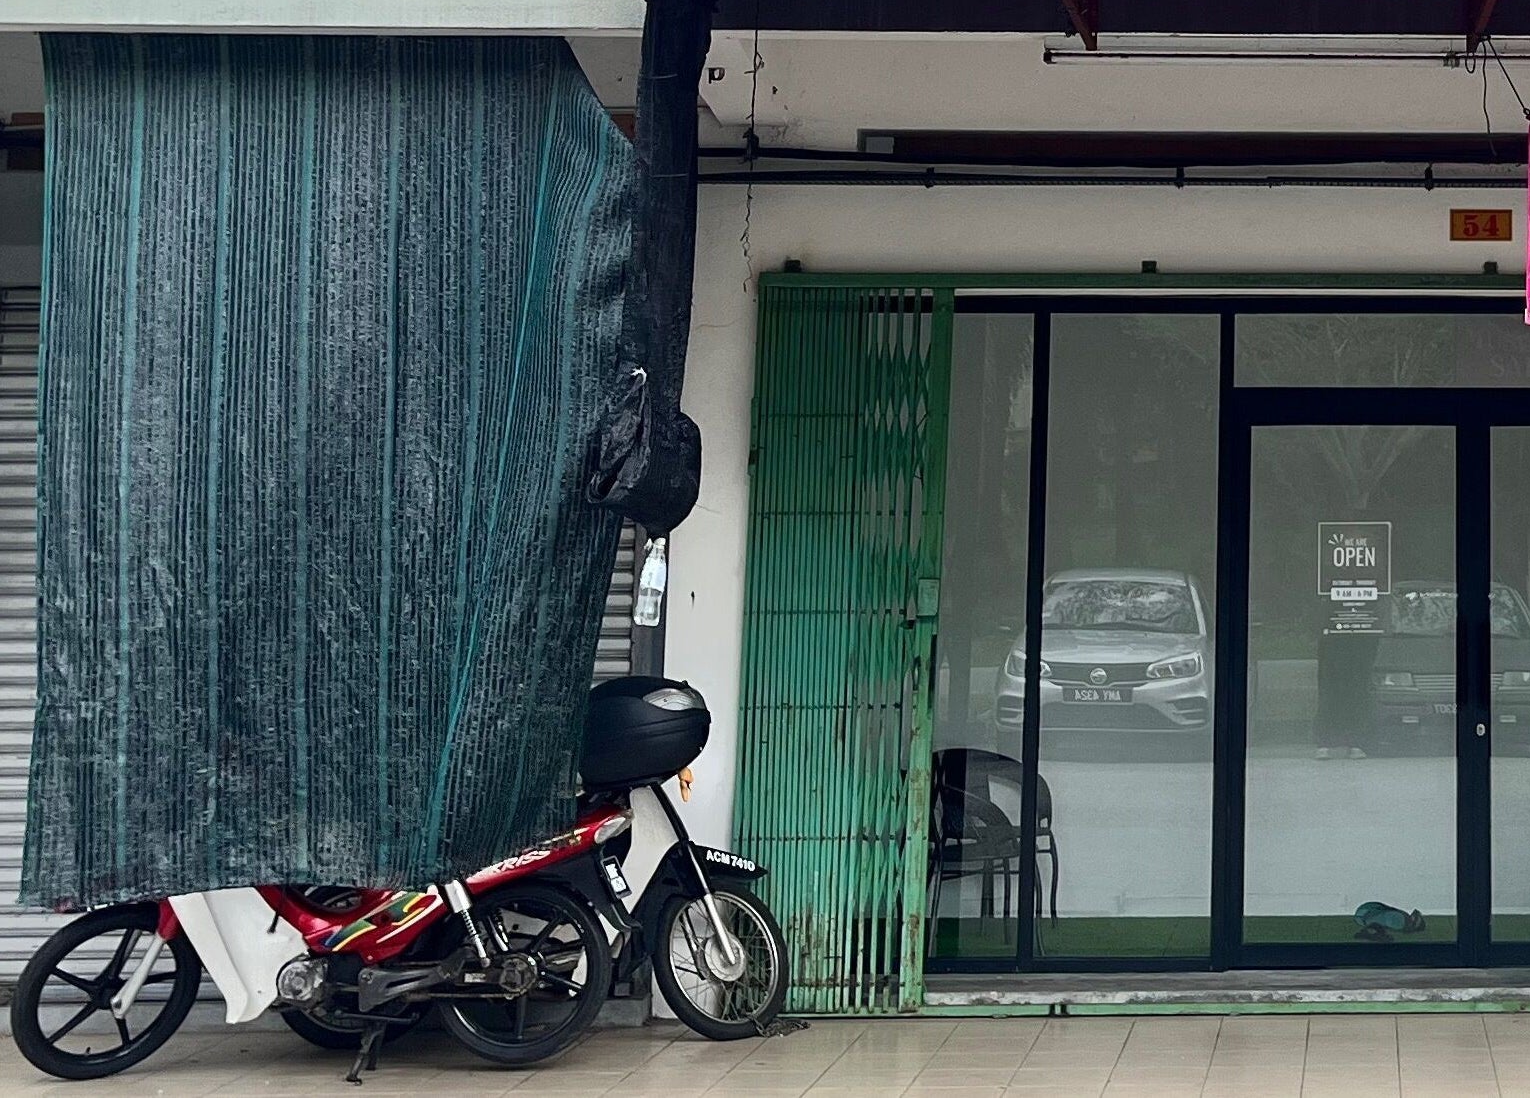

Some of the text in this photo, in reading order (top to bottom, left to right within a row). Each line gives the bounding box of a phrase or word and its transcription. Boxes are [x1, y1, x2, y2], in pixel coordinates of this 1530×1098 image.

[1463, 214, 1500, 237] 54
[1333, 547, 1376, 567] OPEN
[706, 849, 730, 865] ACM
